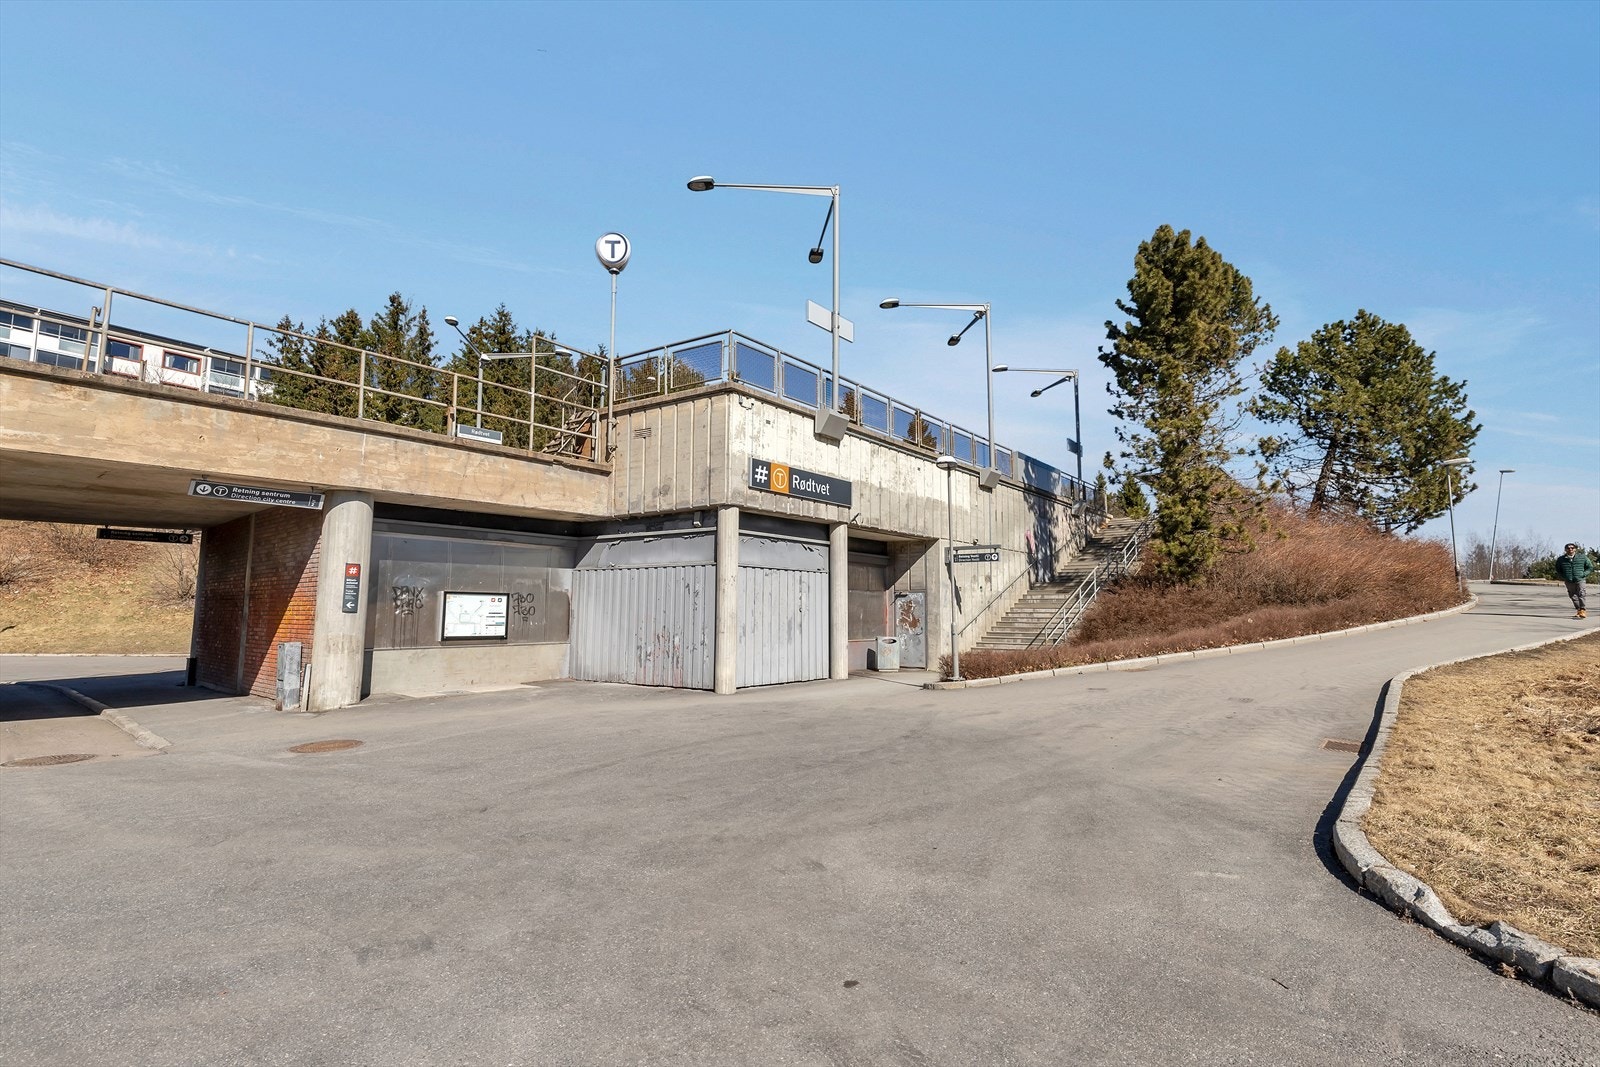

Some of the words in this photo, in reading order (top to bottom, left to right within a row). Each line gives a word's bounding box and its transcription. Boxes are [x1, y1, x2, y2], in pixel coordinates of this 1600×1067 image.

[605, 240, 621, 259] T
[792, 474, 830, 496] Rødtvet
[230, 492, 261, 501] Direction
[262, 495, 275, 503] city
[232, 487, 260, 496] Retning
[261, 491, 291, 499] sentrum
